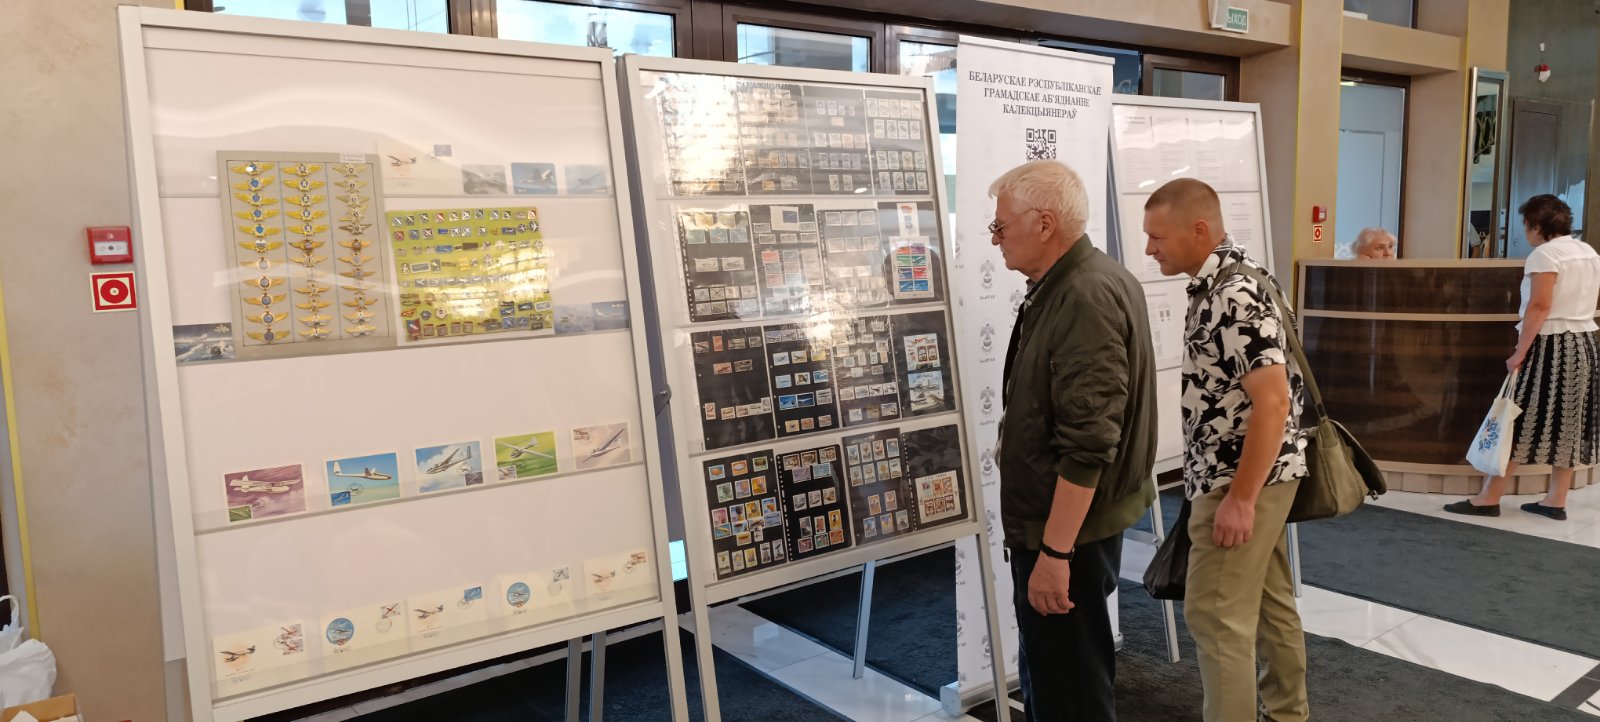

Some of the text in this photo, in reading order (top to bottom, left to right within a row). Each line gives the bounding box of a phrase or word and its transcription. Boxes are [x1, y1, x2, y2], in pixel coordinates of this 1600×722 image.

[1227, 13, 1246, 27] ЫХОД
[969, 70, 1102, 96] БЕЛАРУСКАЕ РЭСПУБЛІКАНСКАЕ
[984, 87, 1040, 102] ГРАМАДСКАЕ
[1003, 104, 1077, 119] КАЛЕКЦЫЯНЕРАЎ
